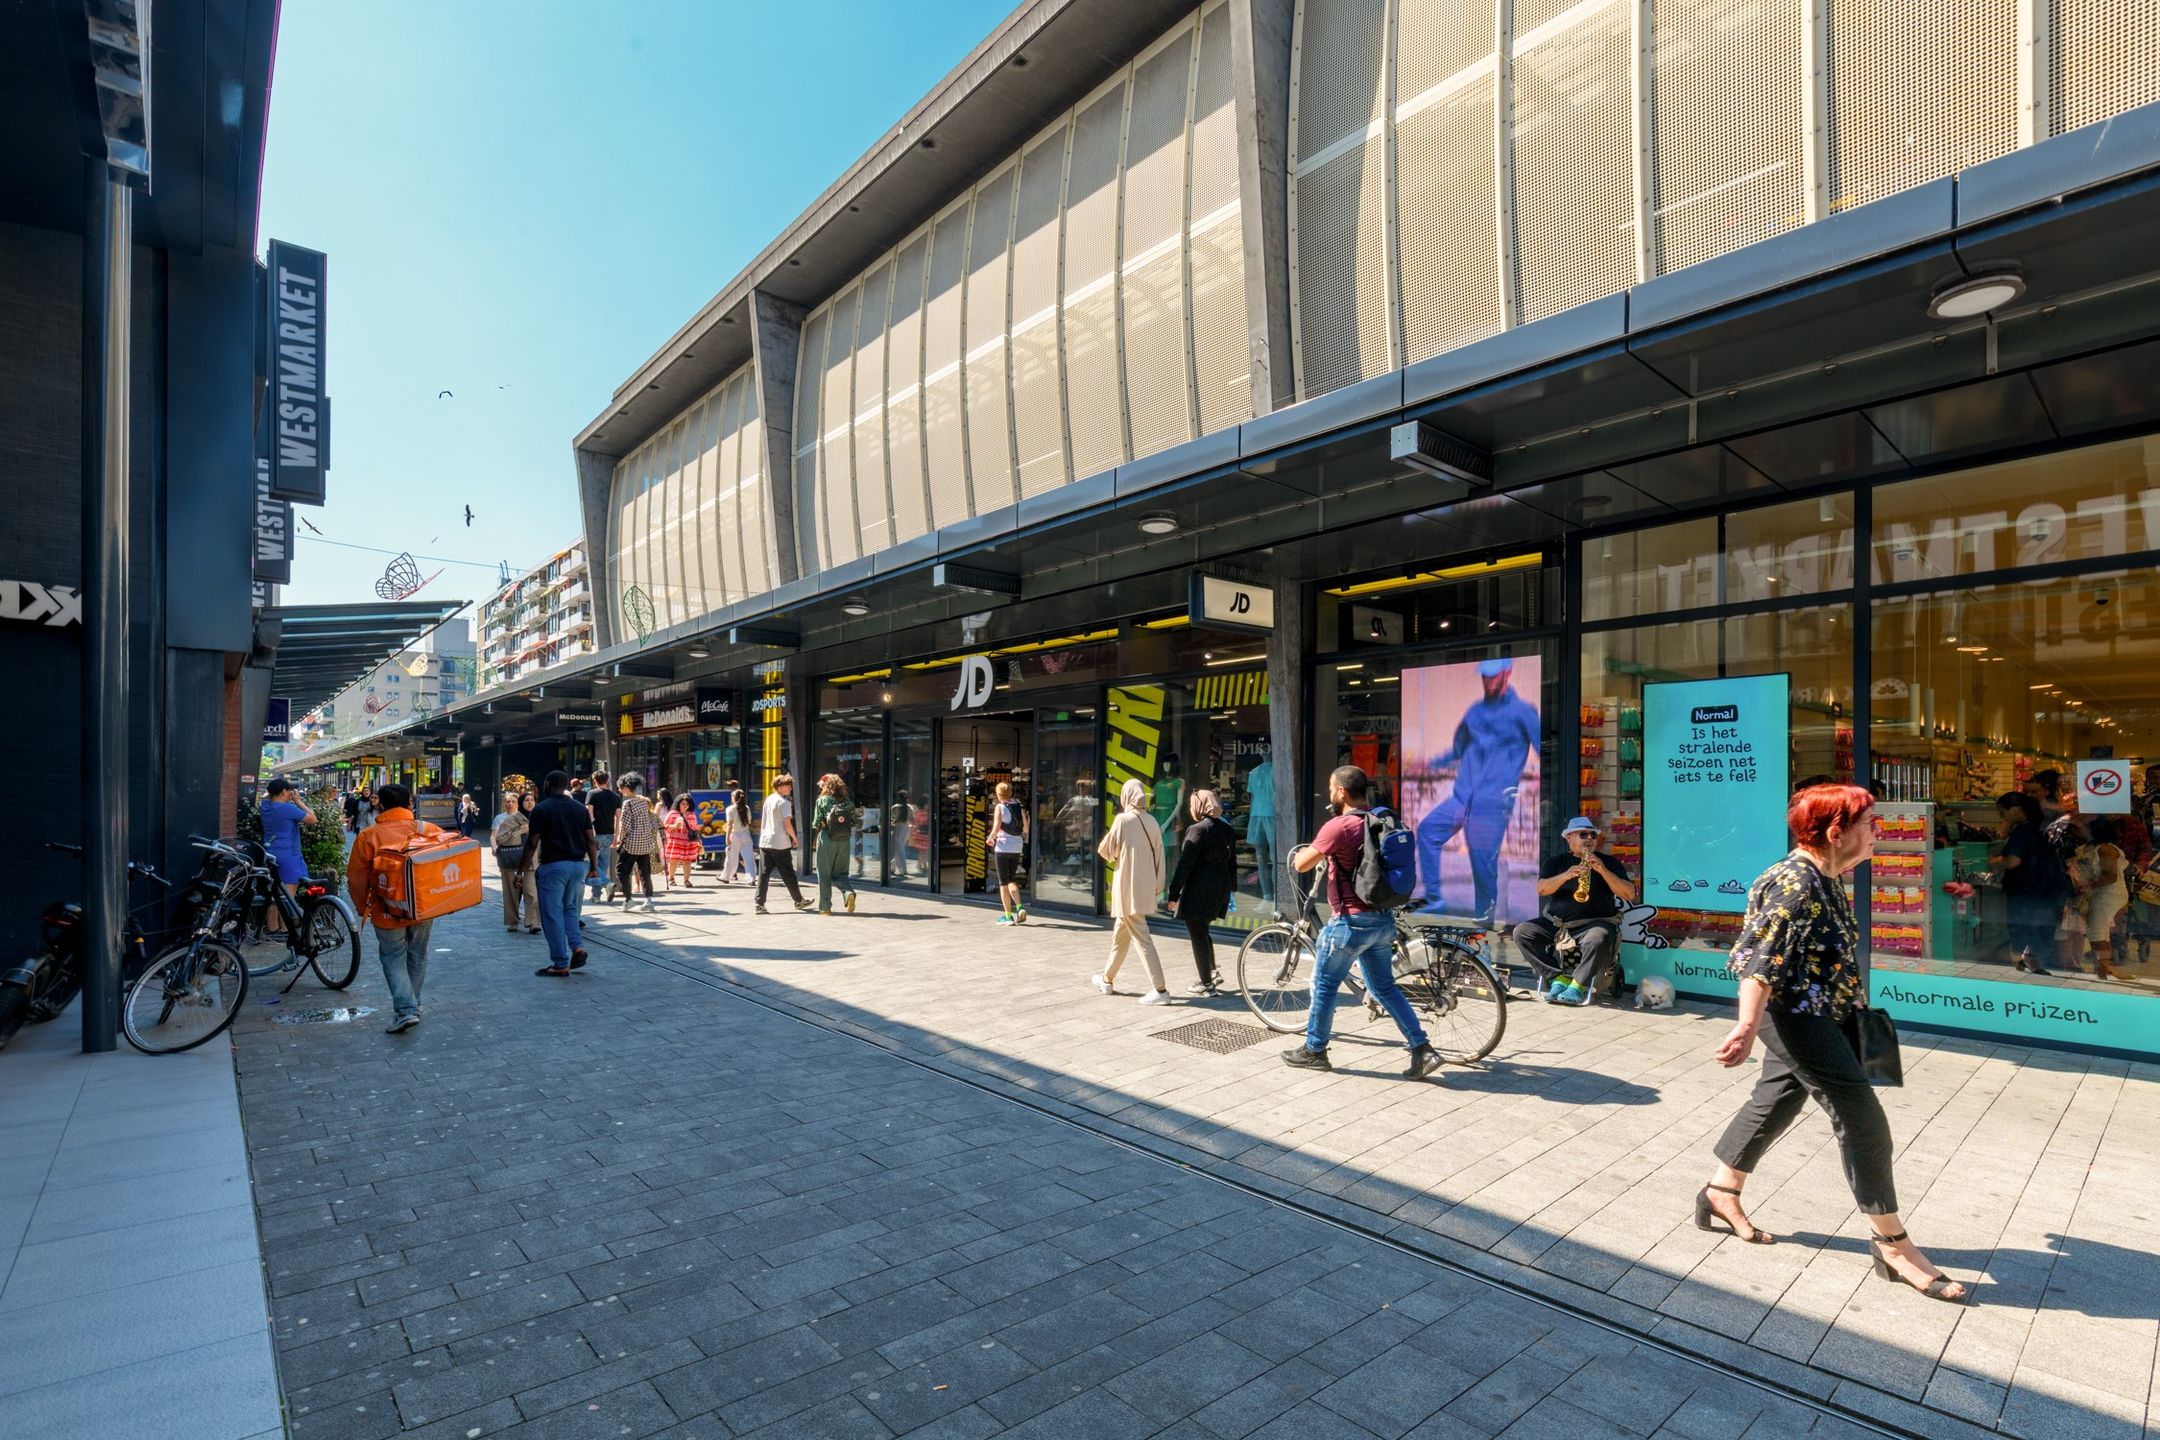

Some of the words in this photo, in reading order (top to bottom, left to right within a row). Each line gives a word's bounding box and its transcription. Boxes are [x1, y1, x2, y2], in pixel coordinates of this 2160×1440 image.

[279, 266, 317, 467] WESTMARKET
[1230, 592, 1250, 613] JD
[950, 655, 993, 711] JD
[559, 713, 602, 721] McDonald's
[642, 705, 696, 728] McDonald's
[1695, 708, 1734, 721] Normal
[1691, 727, 1706, 740] Is
[1711, 725, 1738, 739] het
[1679, 740, 1752, 754] stralende
[1667, 756, 1724, 769] seizoen
[1729, 756, 1757, 768] net
[986, 773, 1012, 783] OFFER
[1674, 770, 1701, 783] iets
[1707, 771, 1724, 783] te
[1729, 768, 1757, 782] fel?
[964, 818, 986, 880] ORWARD
[1674, 961, 1740, 982] Normale
[1879, 985, 1995, 1013] Abnormale
[2004, 1001, 2099, 1024] prijzen.
